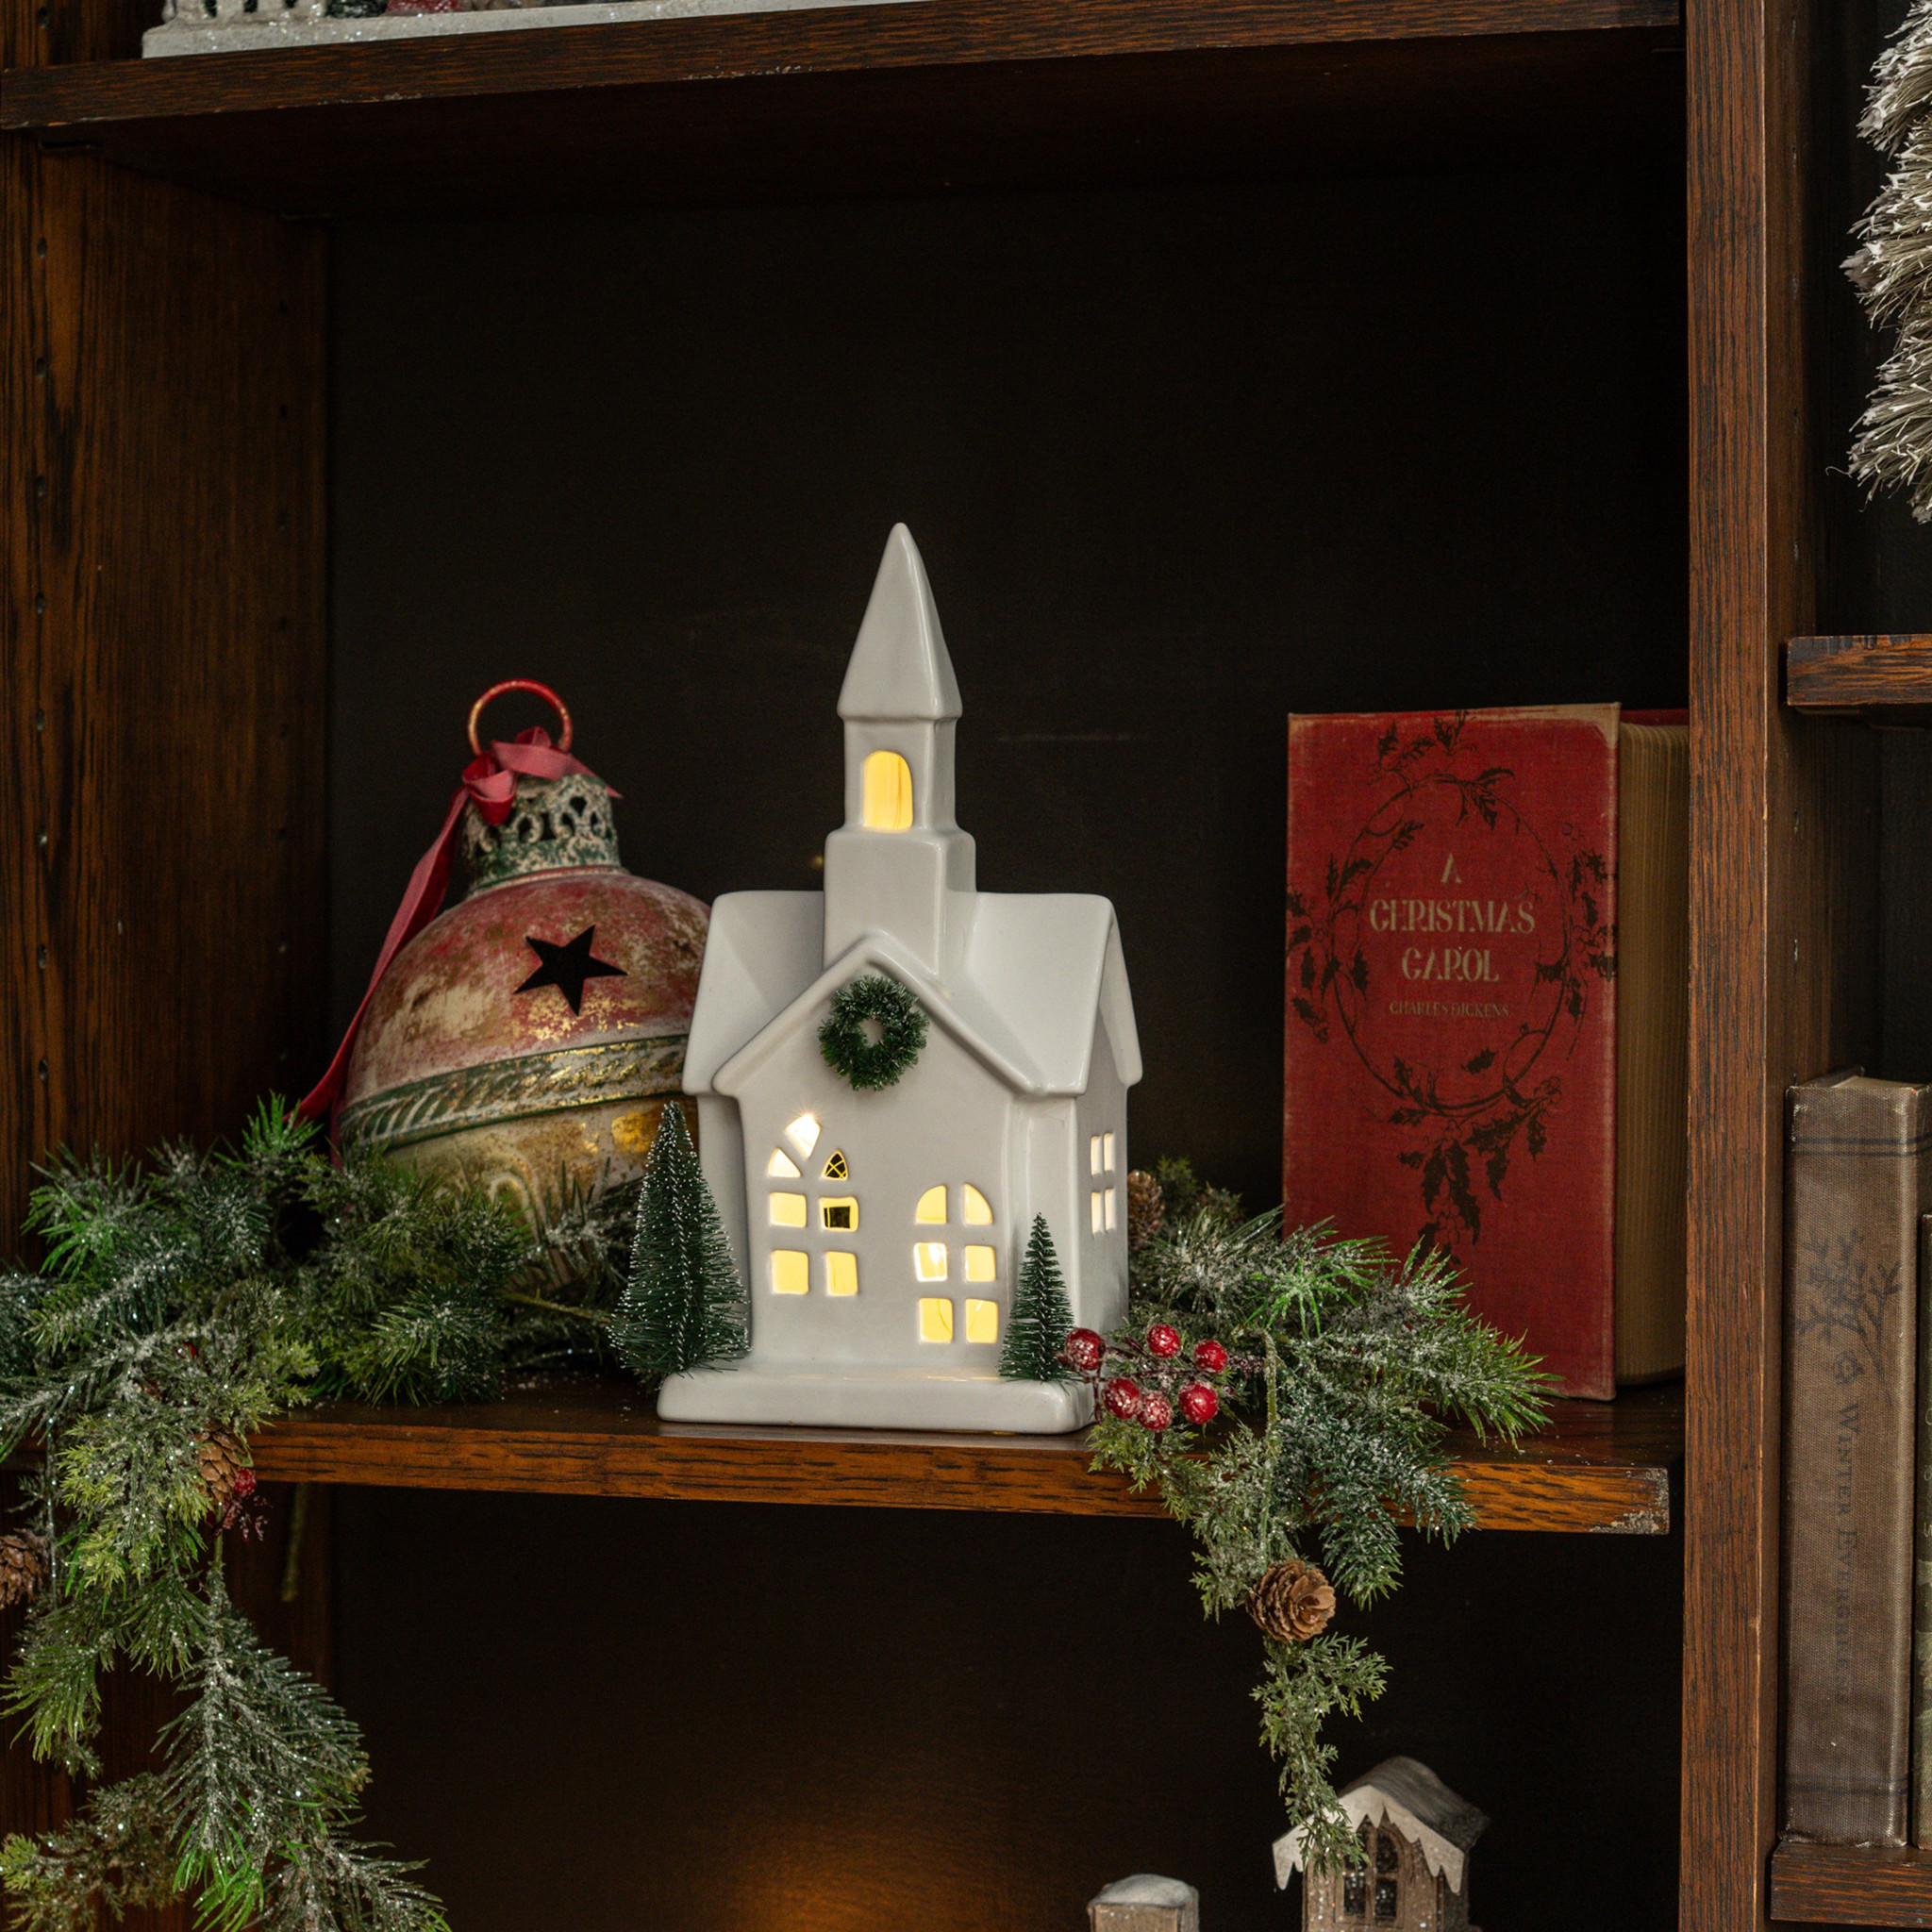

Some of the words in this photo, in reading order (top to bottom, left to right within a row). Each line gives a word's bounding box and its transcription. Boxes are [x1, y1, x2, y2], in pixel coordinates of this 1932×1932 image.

[1441, 852, 1461, 884] A
[1369, 898, 1536, 934] CHRISTMAS
[1401, 946, 1500, 982] CAROL
[1389, 1000, 1449, 1017] CHARLES
[1451, 1002, 1510, 1019] DICKENS
